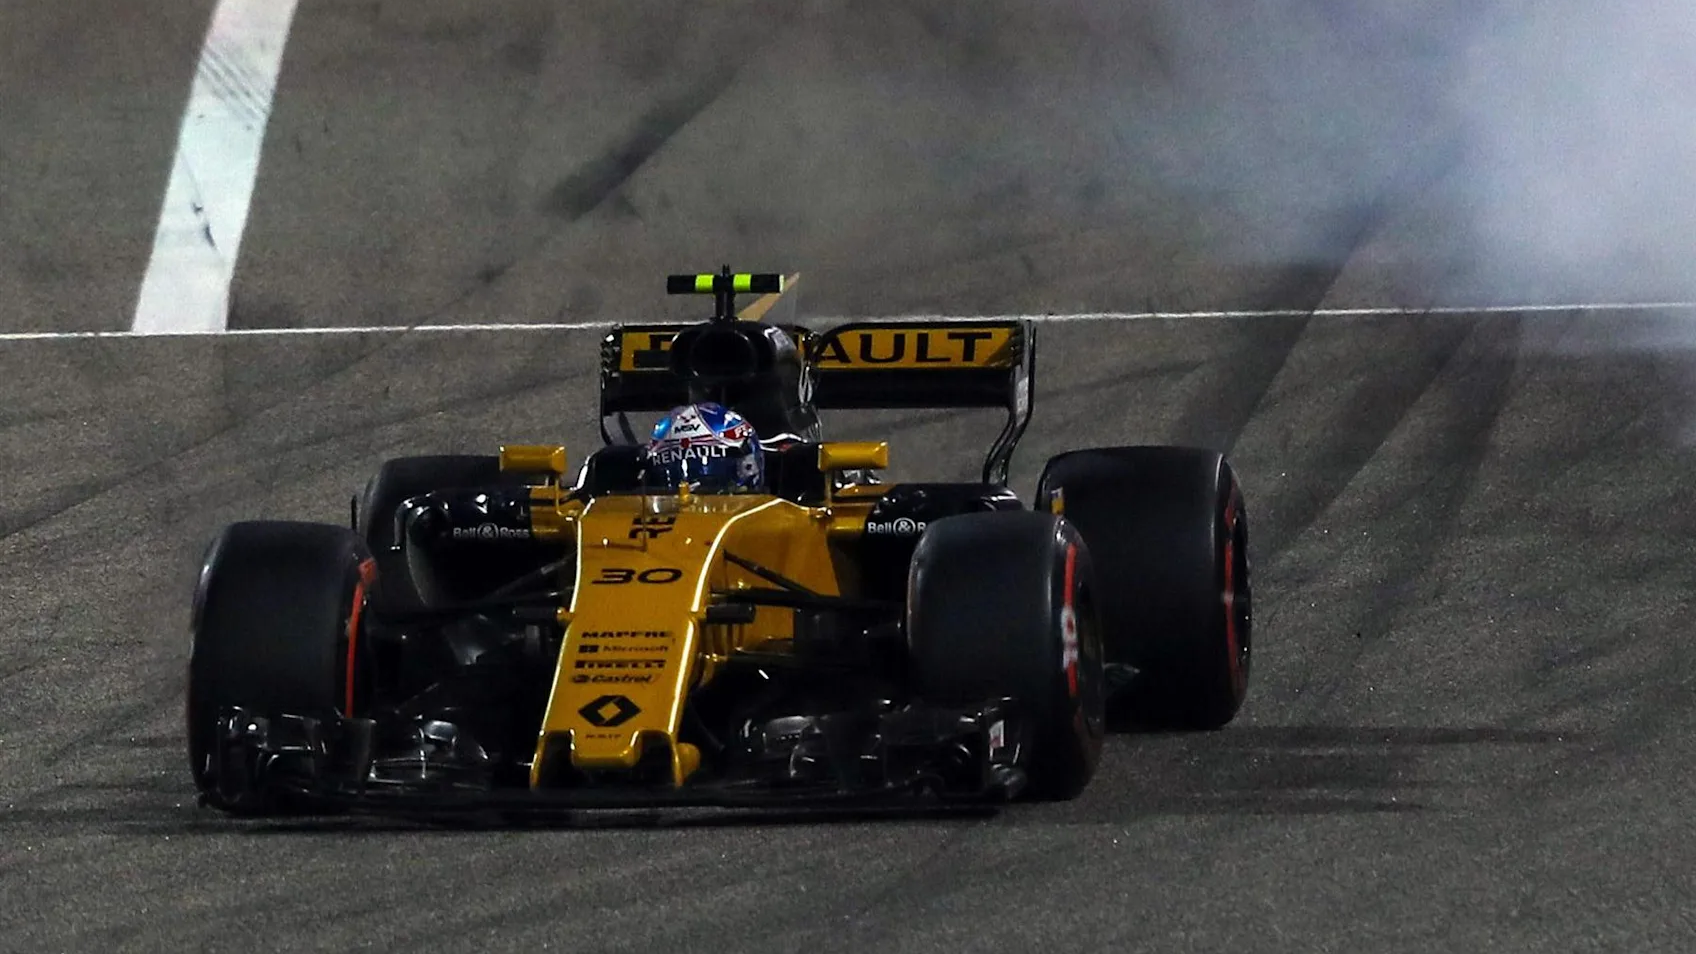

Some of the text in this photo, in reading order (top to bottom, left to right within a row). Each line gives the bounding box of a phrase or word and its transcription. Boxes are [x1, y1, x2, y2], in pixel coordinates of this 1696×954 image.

[674, 424, 701, 434] MSV
[652, 445, 729, 466] RENAULT
[499, 526, 530, 538] Ross
[867, 521, 891, 534] Bell
[591, 568, 683, 585] 30
